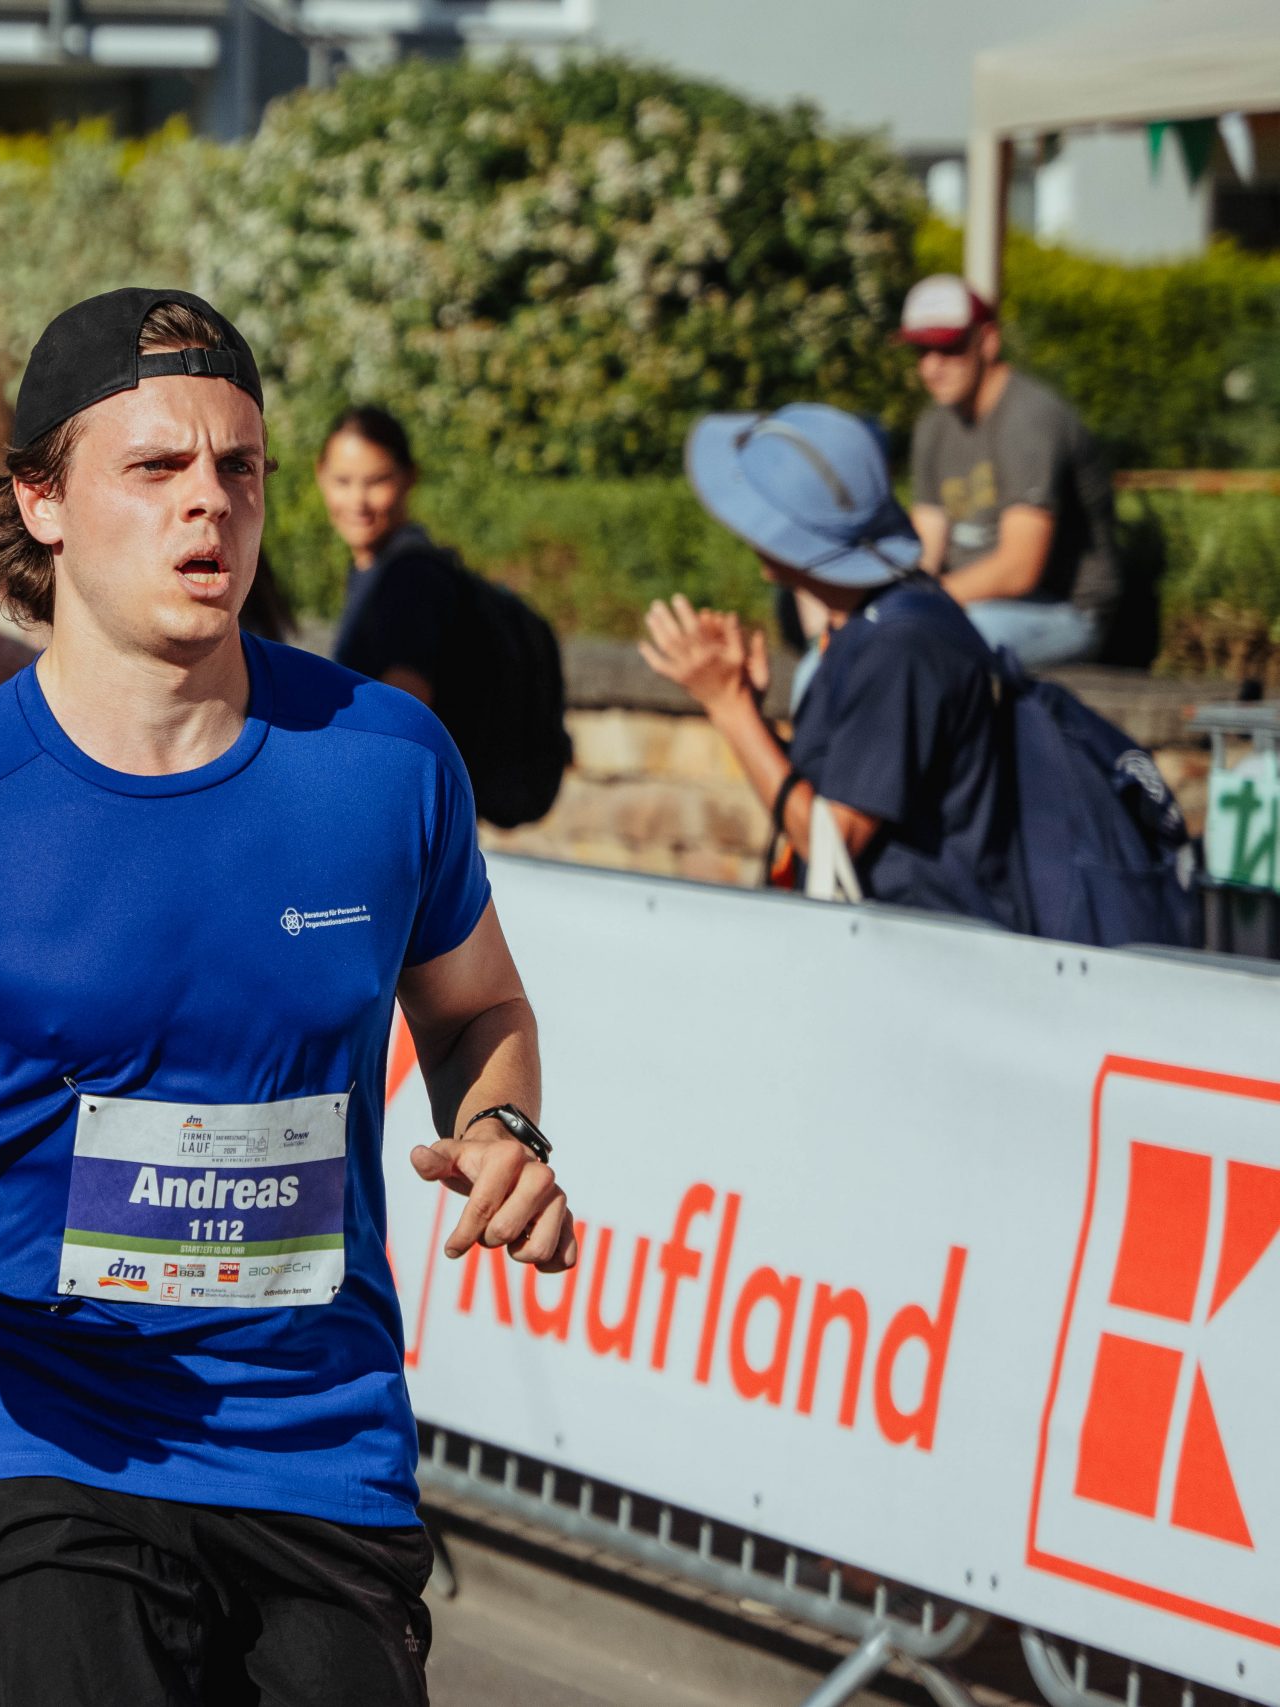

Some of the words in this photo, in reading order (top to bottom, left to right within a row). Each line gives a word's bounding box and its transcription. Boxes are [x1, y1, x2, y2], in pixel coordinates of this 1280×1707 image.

[186, 1114, 202, 1124] dm
[183, 1132, 212, 1141] FIRMEN
[181, 1142, 211, 1153] LAUF
[128, 1166, 299, 1210] Andreas
[188, 1219, 245, 1241] 1112
[180, 1244, 213, 1254] STARTZEIT
[231, 1245, 245, 1255] UHR
[107, 1257, 146, 1279] dm
[179, 1269, 205, 1278] 88.3
